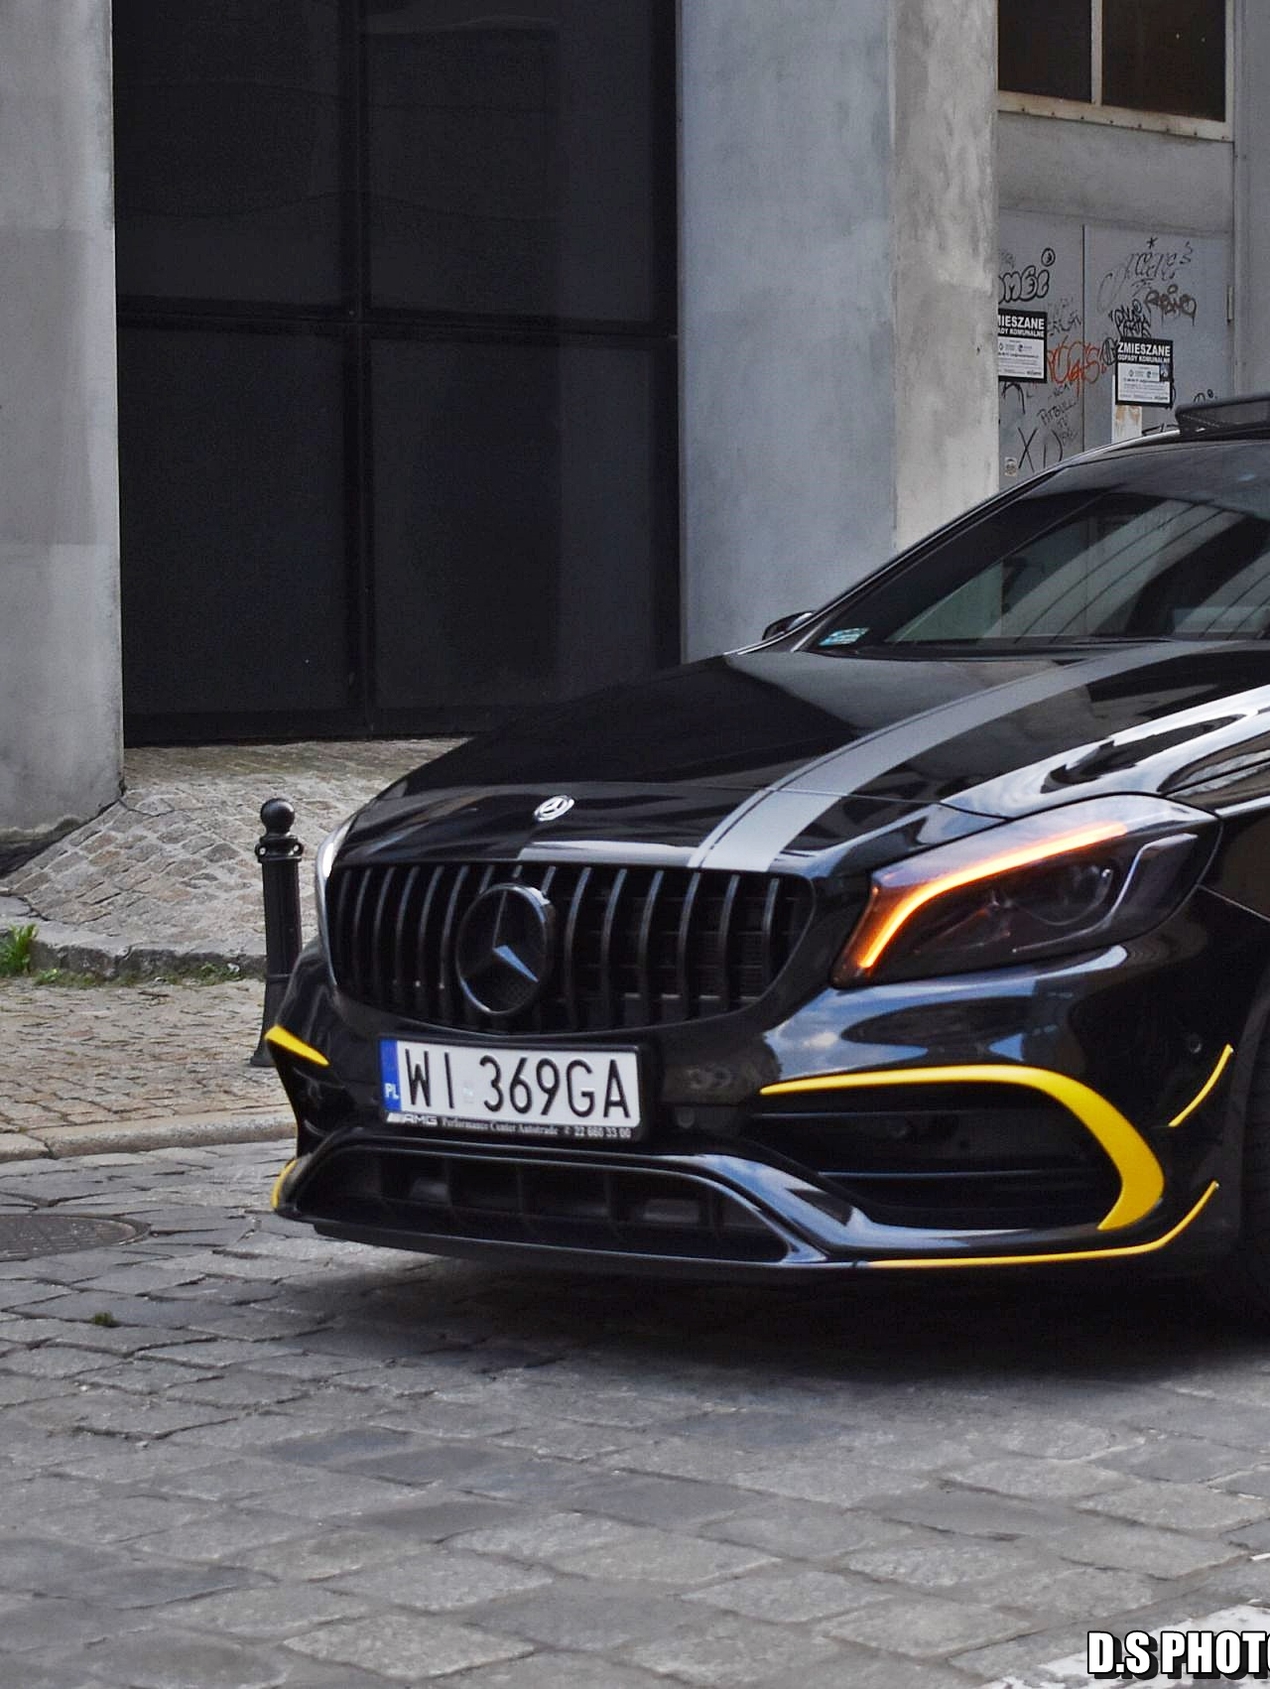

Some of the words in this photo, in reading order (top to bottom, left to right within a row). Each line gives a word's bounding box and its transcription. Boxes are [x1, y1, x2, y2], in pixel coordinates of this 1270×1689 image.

[1118, 341, 1171, 357] ZMIESZANE
[384, 1083, 399, 1099] PL
[405, 1049, 454, 1109] WI
[479, 1055, 631, 1118] 369GA
[404, 1114, 438, 1125] AMG
